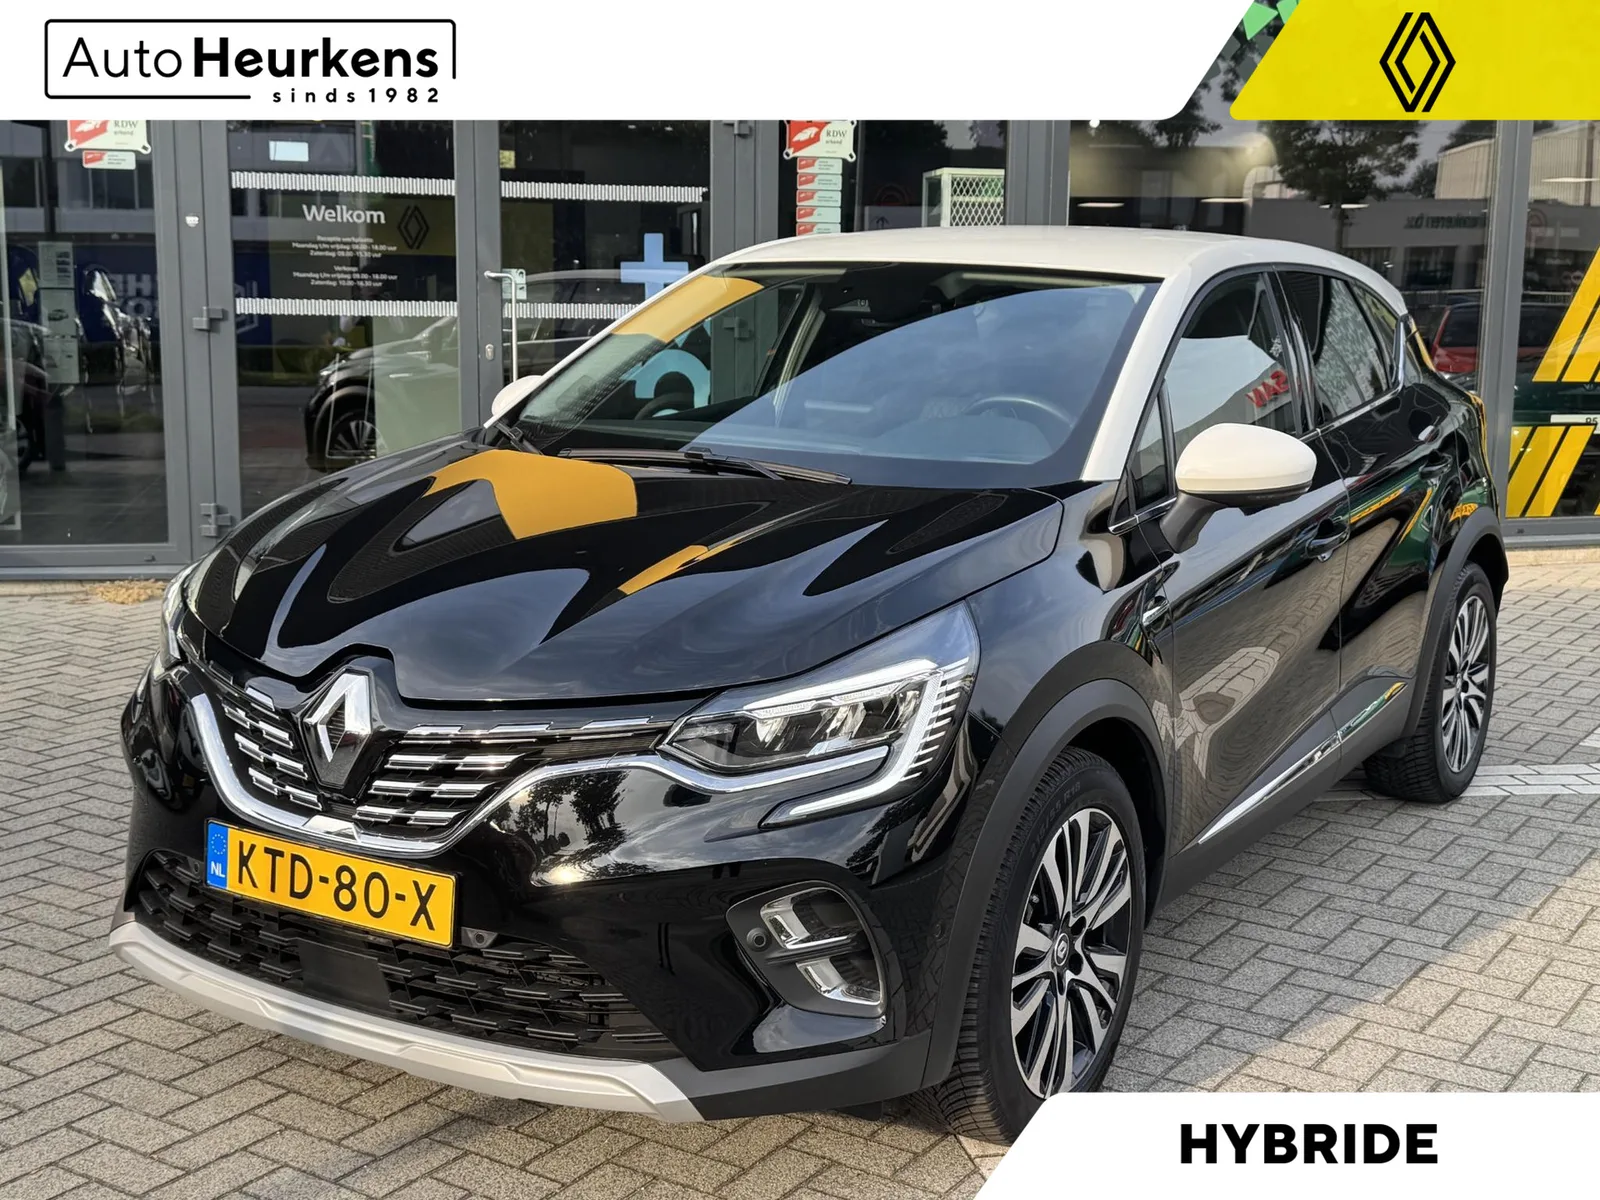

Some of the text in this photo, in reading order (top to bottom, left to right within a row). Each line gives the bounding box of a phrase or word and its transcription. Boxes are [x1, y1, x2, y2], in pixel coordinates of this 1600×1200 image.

[114, 120, 139, 129] RDW
[826, 129, 848, 138] RDW
[302, 203, 386, 224] Welkom
[210, 860, 226, 878] NL
[238, 840, 437, 931] KTD-80-X
